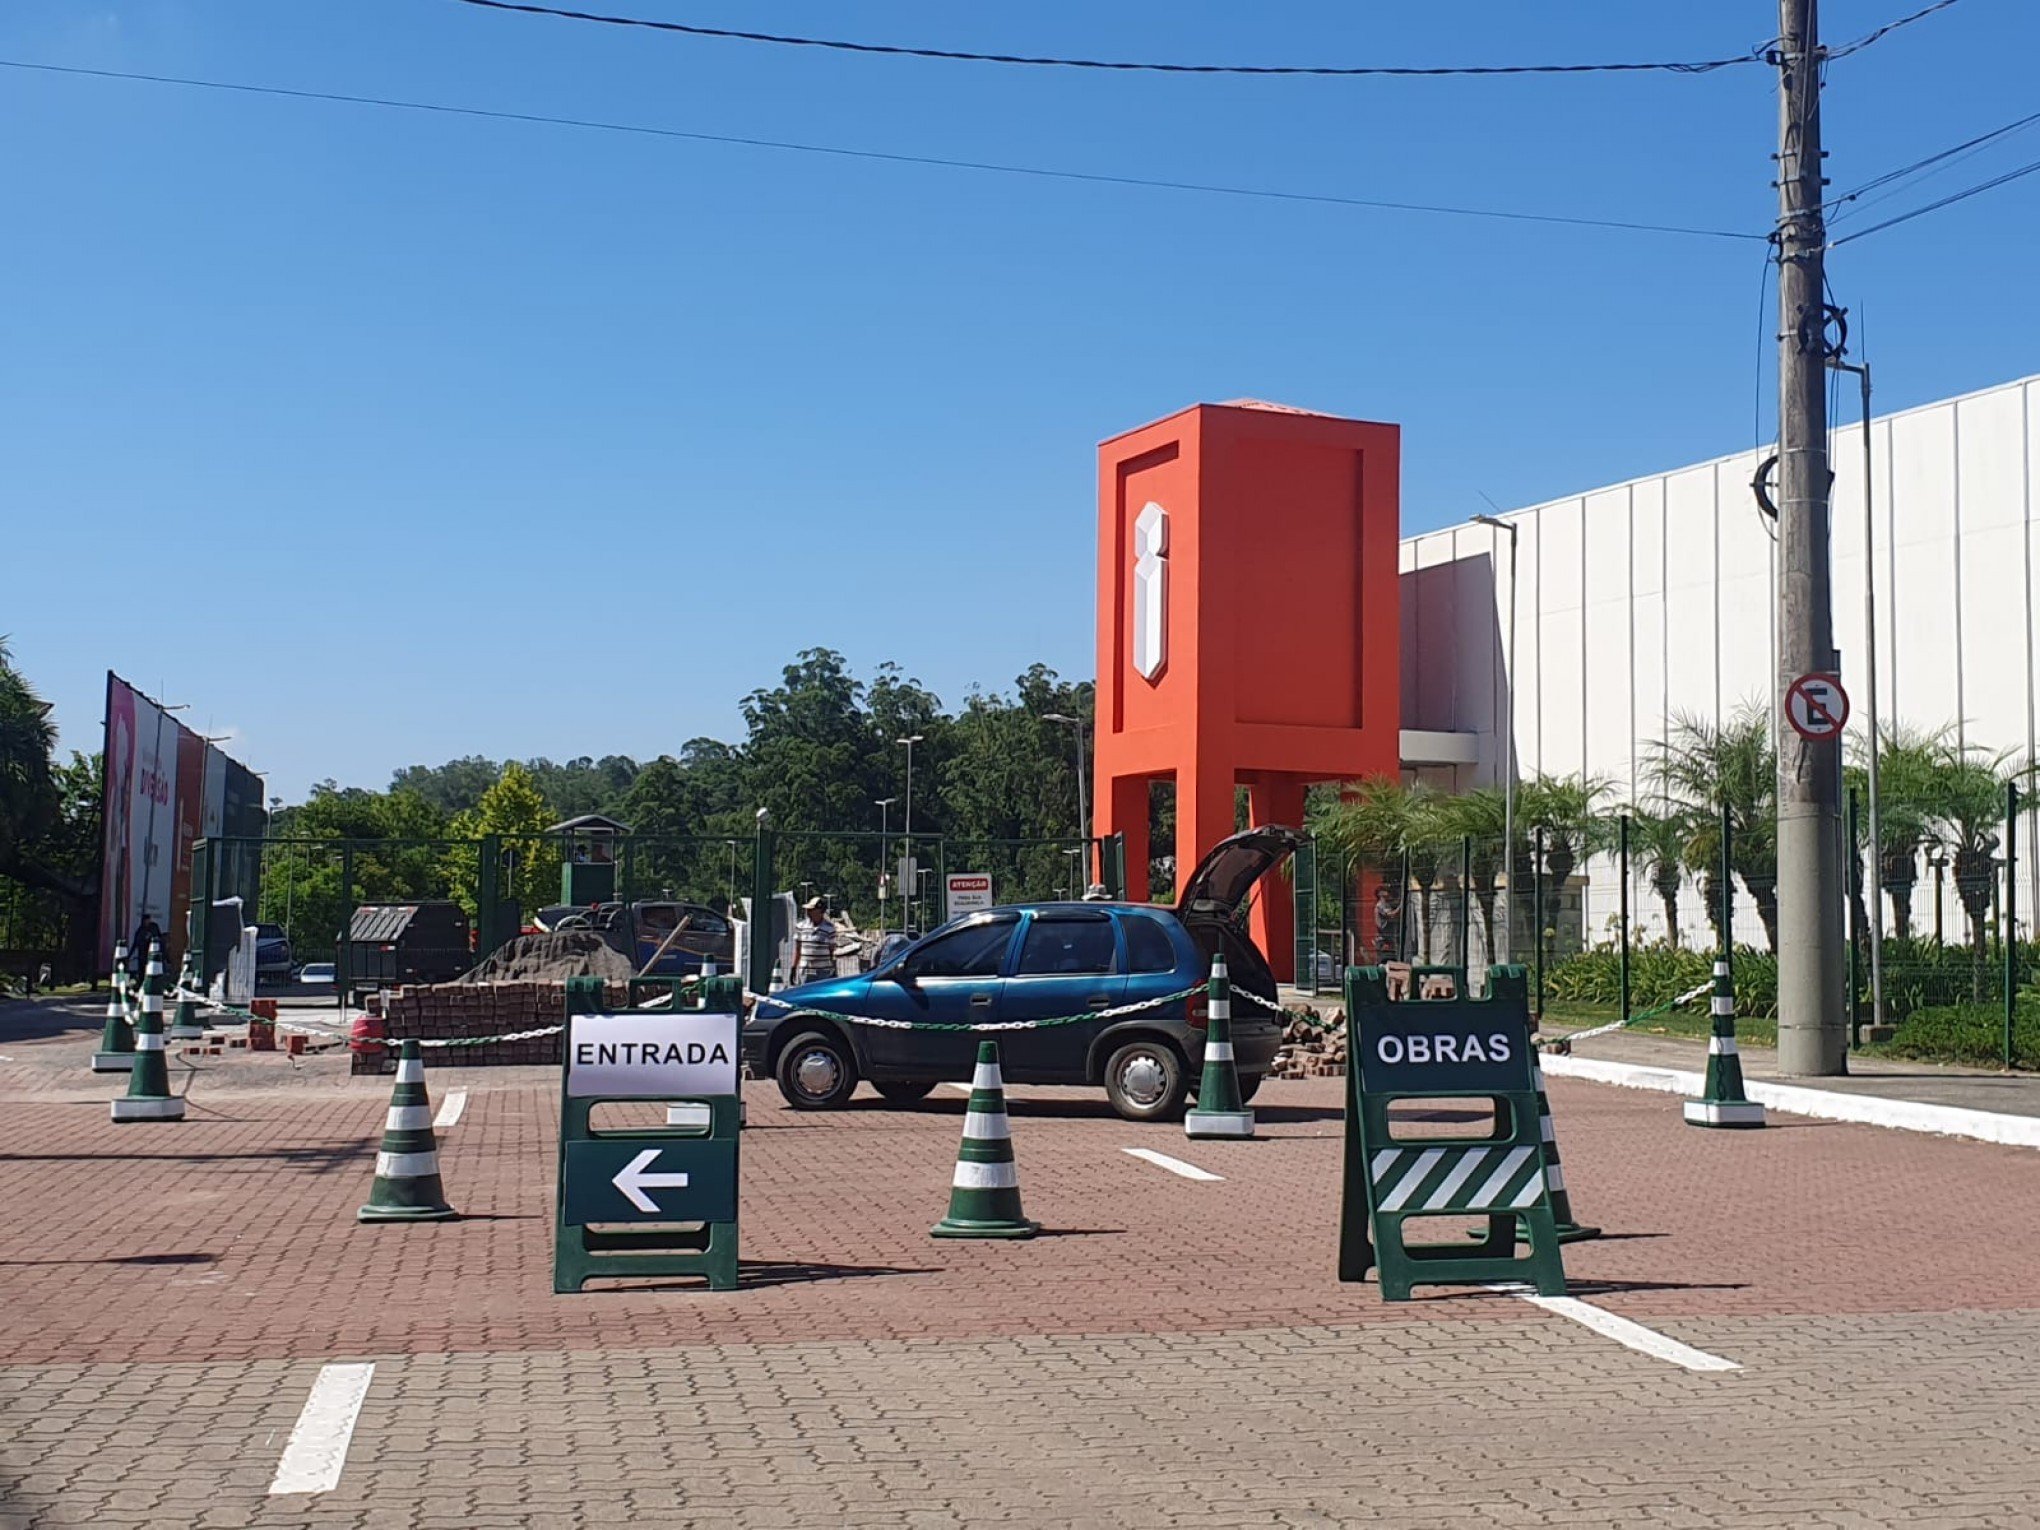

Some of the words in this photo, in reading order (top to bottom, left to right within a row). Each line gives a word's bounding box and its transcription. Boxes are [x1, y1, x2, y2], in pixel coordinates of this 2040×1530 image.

[1806, 688, 1829, 724] E
[576, 1043, 729, 1065] ENTRADA
[1377, 1033, 1511, 1063] OBRAS
